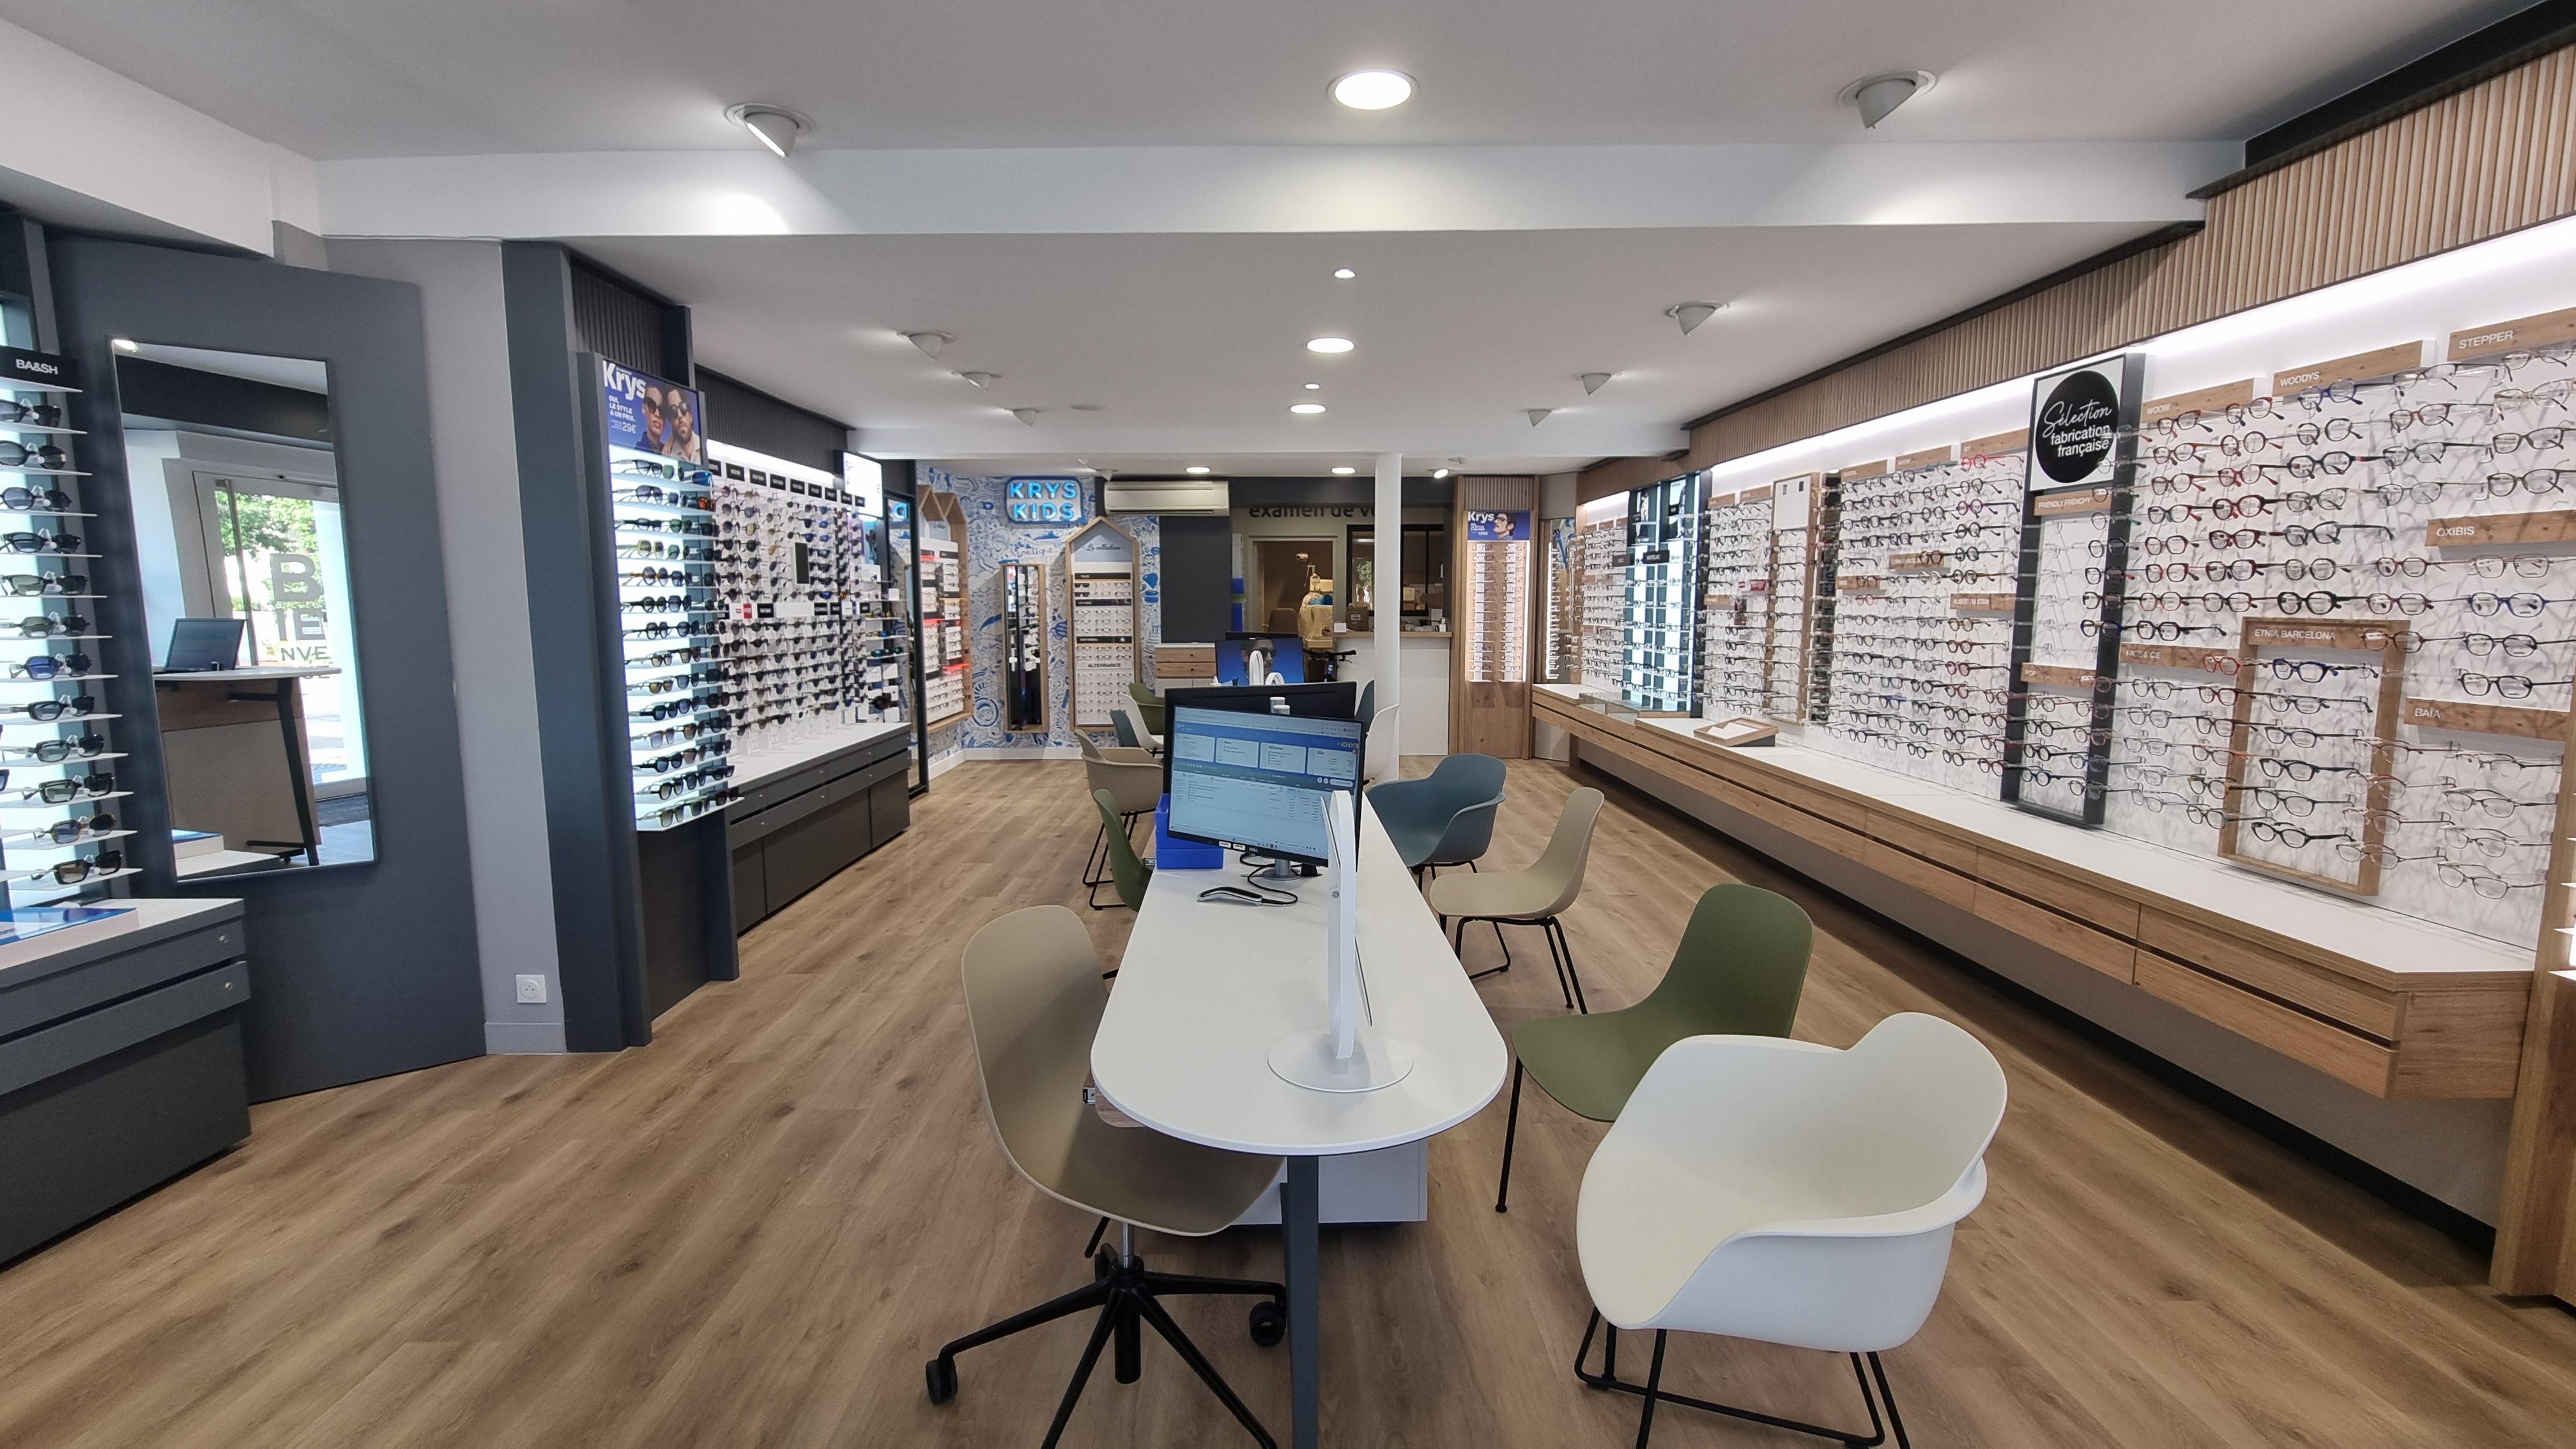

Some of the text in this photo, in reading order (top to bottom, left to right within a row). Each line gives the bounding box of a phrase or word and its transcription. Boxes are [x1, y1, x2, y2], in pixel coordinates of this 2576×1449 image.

[2458, 330, 2514, 349] STEPPER
[15, 358, 58, 375] BA&SH
[602, 360, 647, 401] Krys
[2280, 371, 2320, 387] WOODYS
[617, 404, 632, 415] STYLE
[2147, 403, 2171, 415] WOOW
[2043, 399, 2112, 438] Sélection
[2051, 424, 2112, 446] fabrication
[2057, 438, 2110, 458] française
[1009, 481, 1078, 500] KRYS
[1012, 502, 1075, 521] KIDS
[1249, 507, 1324, 518] examen
[1468, 510, 1495, 523] Krys
[2436, 526, 2475, 537] OXIBIS
[270, 553, 321, 602] B
[275, 608, 326, 641] IE
[2280, 629, 2336, 641] BARCELONA
[280, 645, 331, 661] NVE
